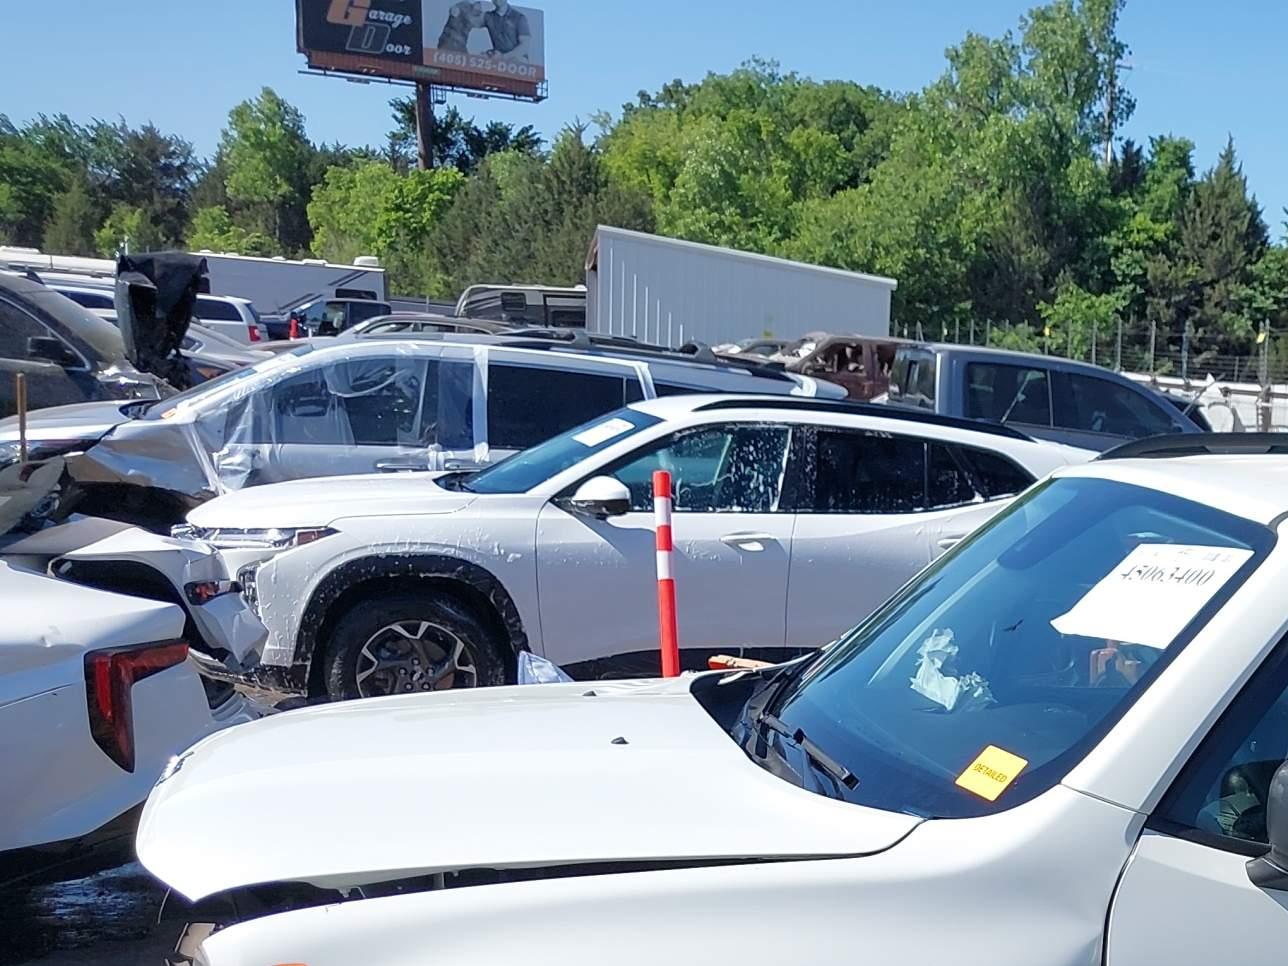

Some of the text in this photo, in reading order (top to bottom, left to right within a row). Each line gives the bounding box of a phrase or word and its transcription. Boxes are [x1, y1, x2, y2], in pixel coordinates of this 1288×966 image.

[345, 21, 412, 55] Door
[433, 51, 466, 66] (405)
[973, 763, 1008, 783] DETAILED
